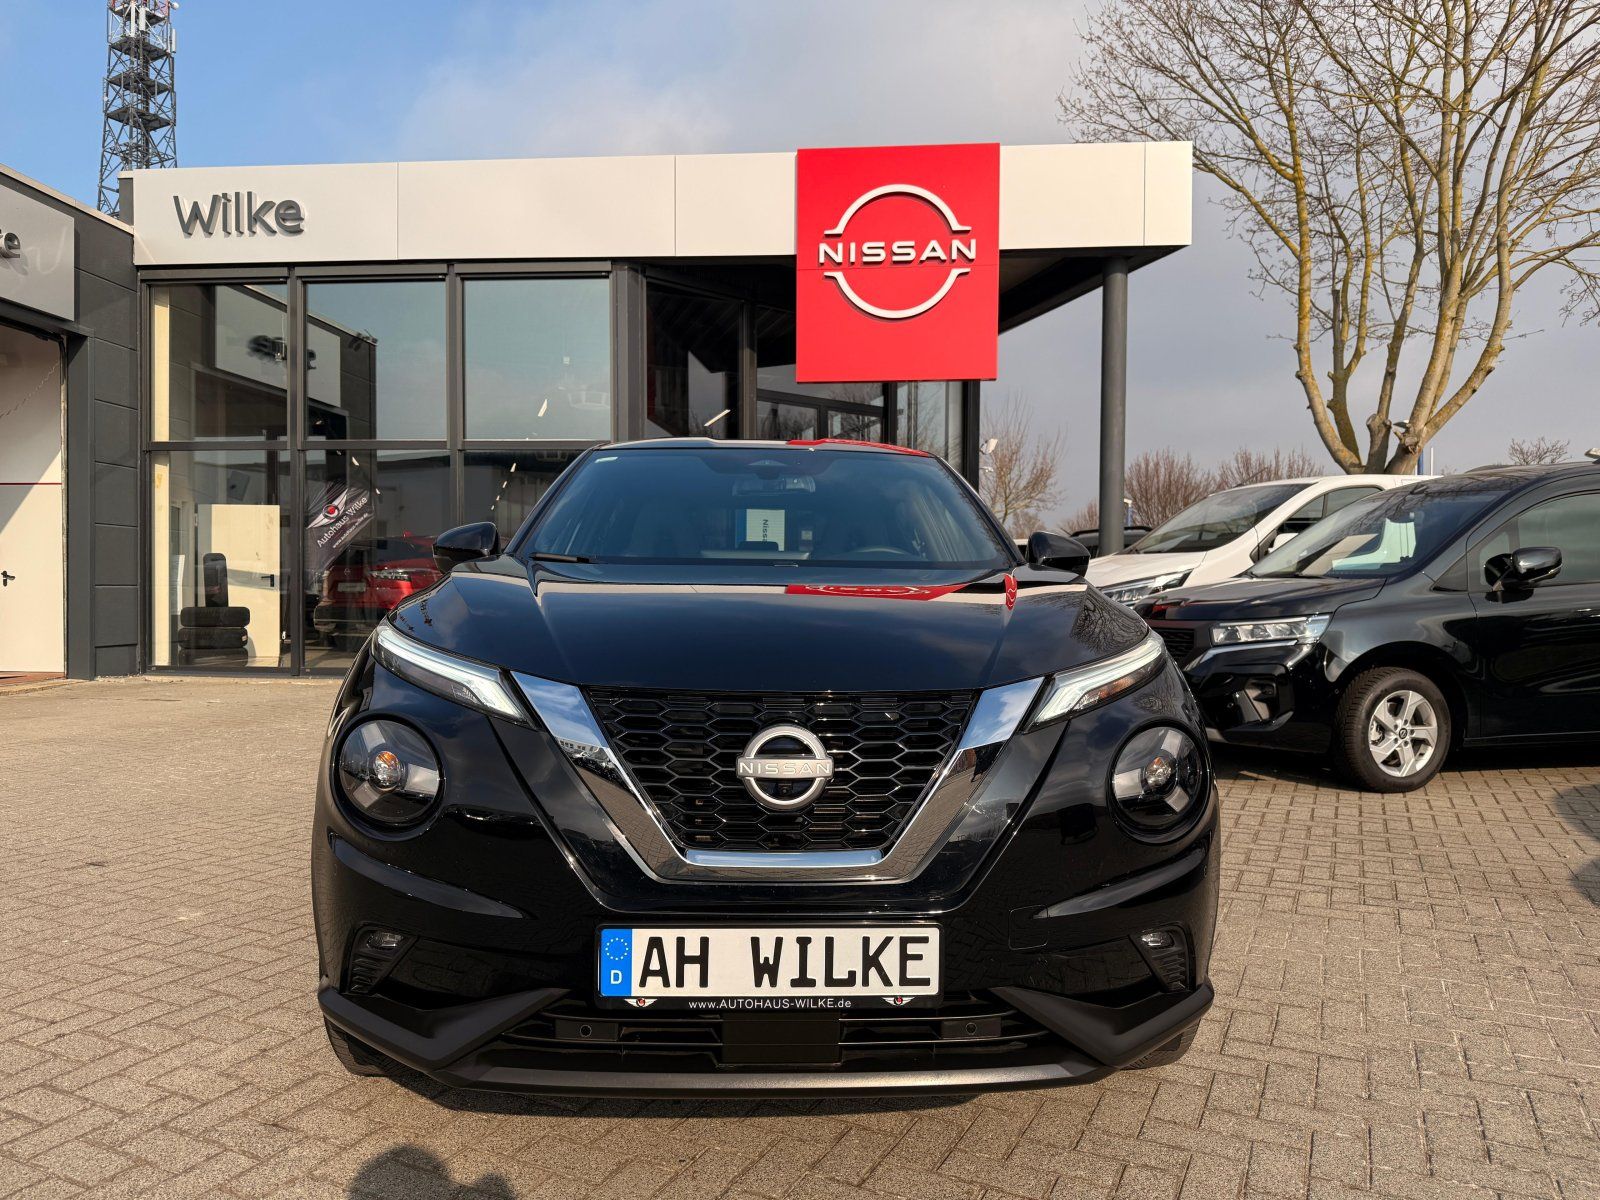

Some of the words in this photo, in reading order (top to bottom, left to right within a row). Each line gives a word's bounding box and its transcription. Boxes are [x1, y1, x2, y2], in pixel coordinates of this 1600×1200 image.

[173, 191, 304, 235] Wilke
[818, 238, 977, 264] NISSAN
[316, 515, 350, 548] Autohaus
[345, 497, 368, 516] Wilke
[739, 762, 831, 775] NISSAN
[610, 969, 623, 985] D
[638, 936, 710, 988] AH
[750, 935, 931, 988] WILKE
[688, 998, 852, 1010] www.AUTOHAUS-WILKE.de
